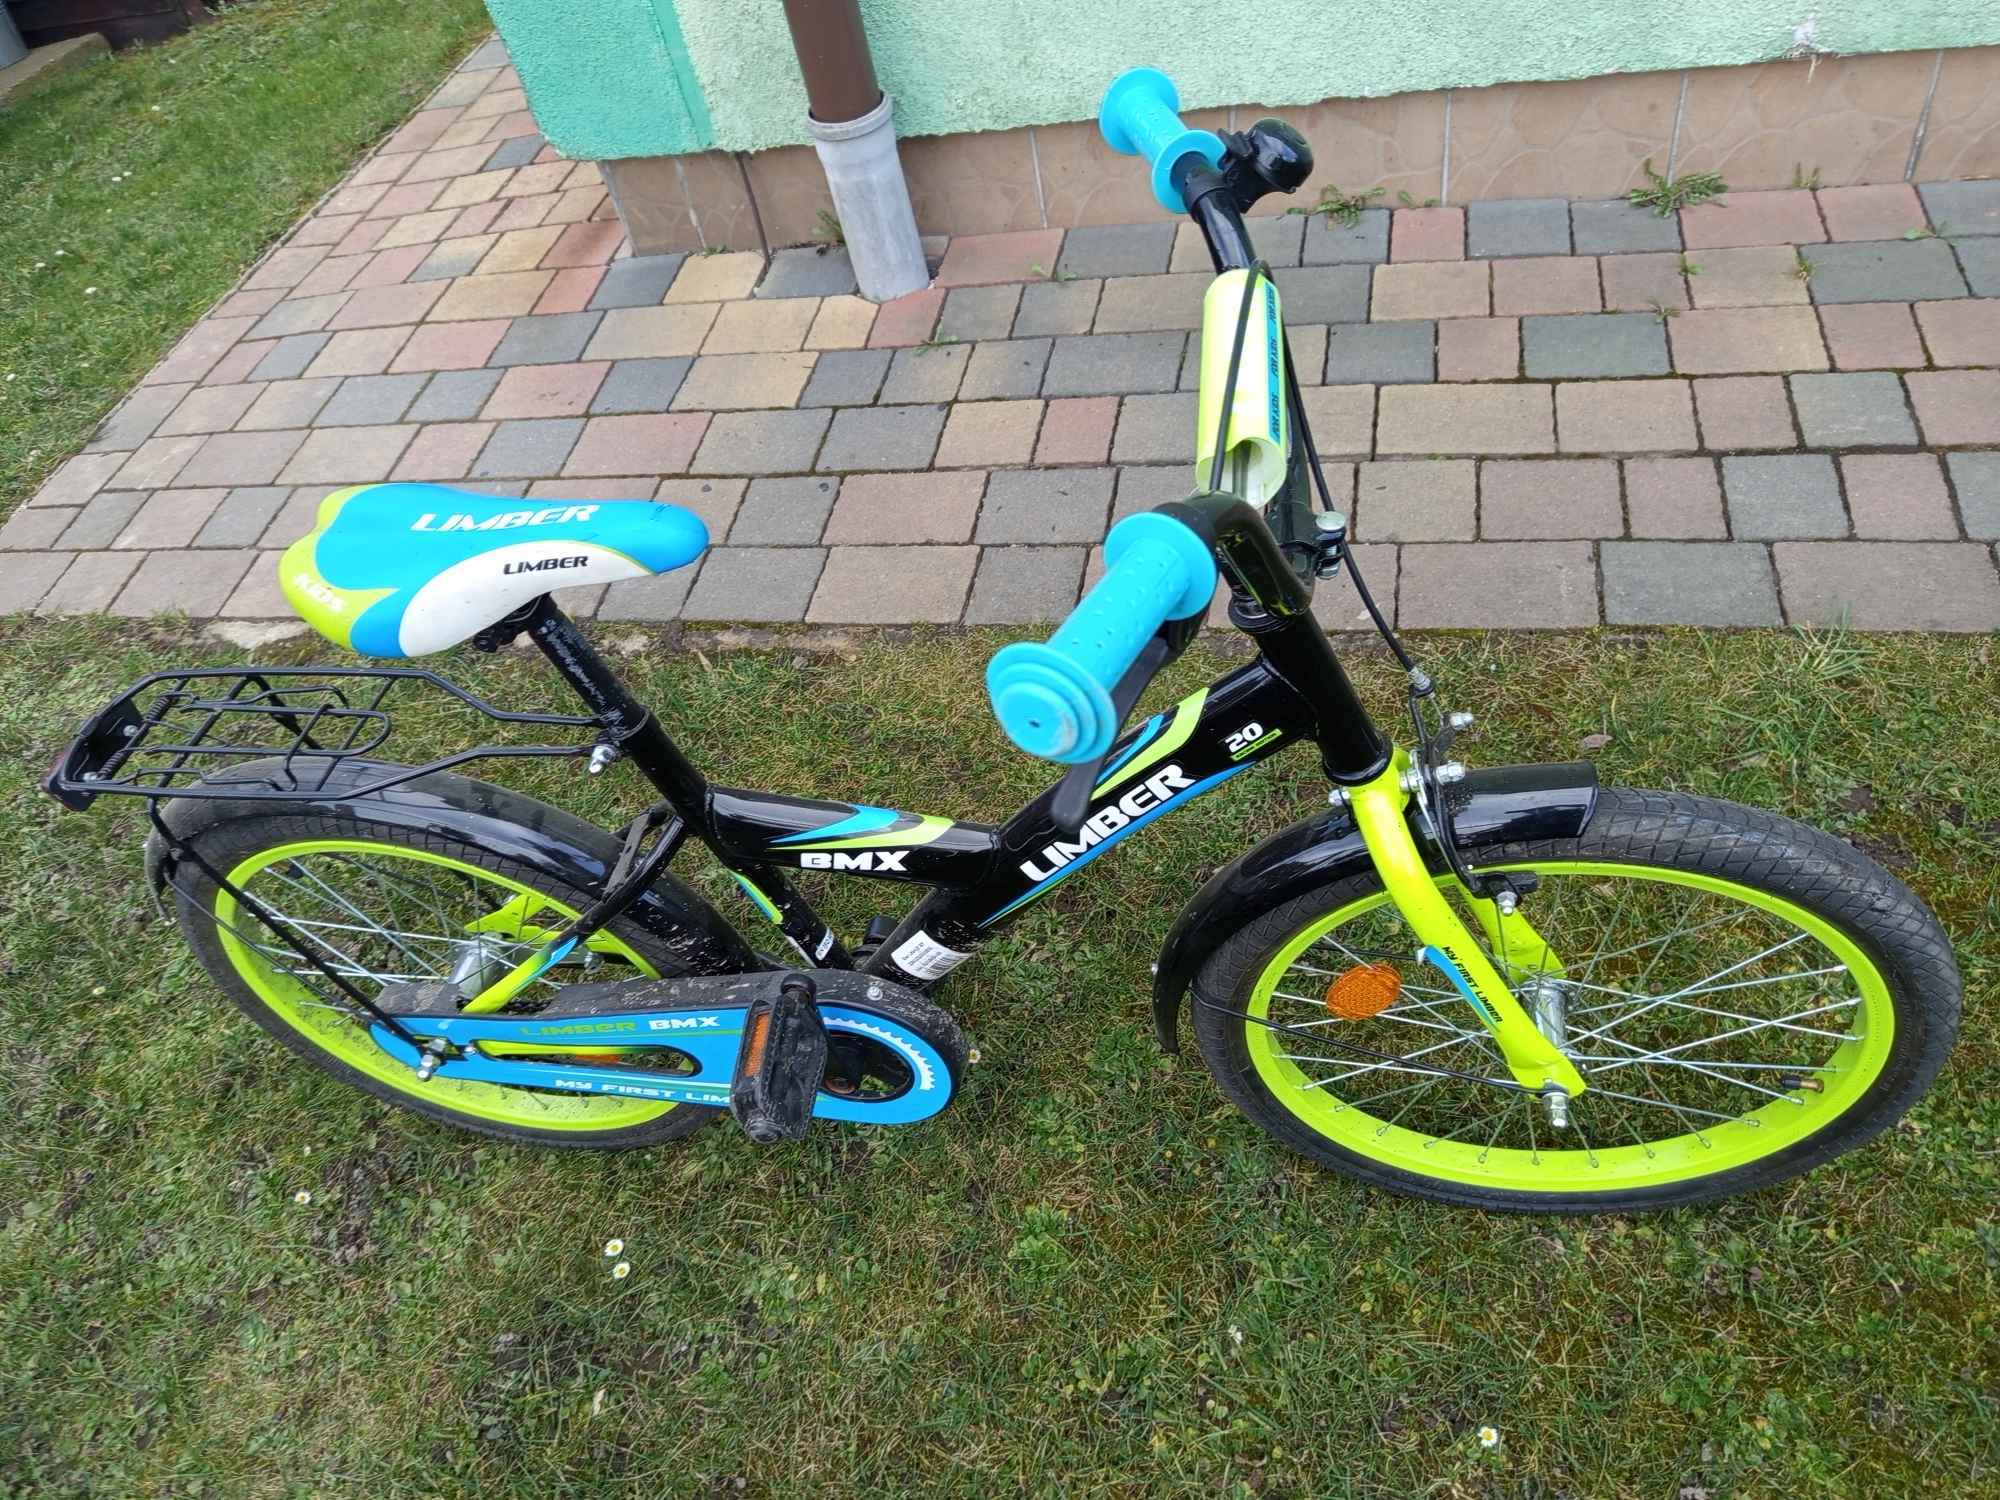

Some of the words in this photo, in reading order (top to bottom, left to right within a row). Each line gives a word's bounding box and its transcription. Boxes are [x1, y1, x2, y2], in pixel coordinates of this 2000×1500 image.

[410, 504, 600, 532] LIMBER
[503, 555, 589, 575] LIMBER
[1224, 722, 1264, 753] 20
[1019, 764, 1197, 882] LIMBER
[800, 850, 910, 871] BMX
[1441, 946, 1458, 961] MY
[1455, 962, 1479, 988] FIRST
[520, 1021, 636, 1036] LIMBER
[648, 1016, 720, 1030] BMX
[555, 1079, 592, 1089] MY
[601, 1083, 677, 1098] FIRST
[686, 1092, 732, 1104] LIM
